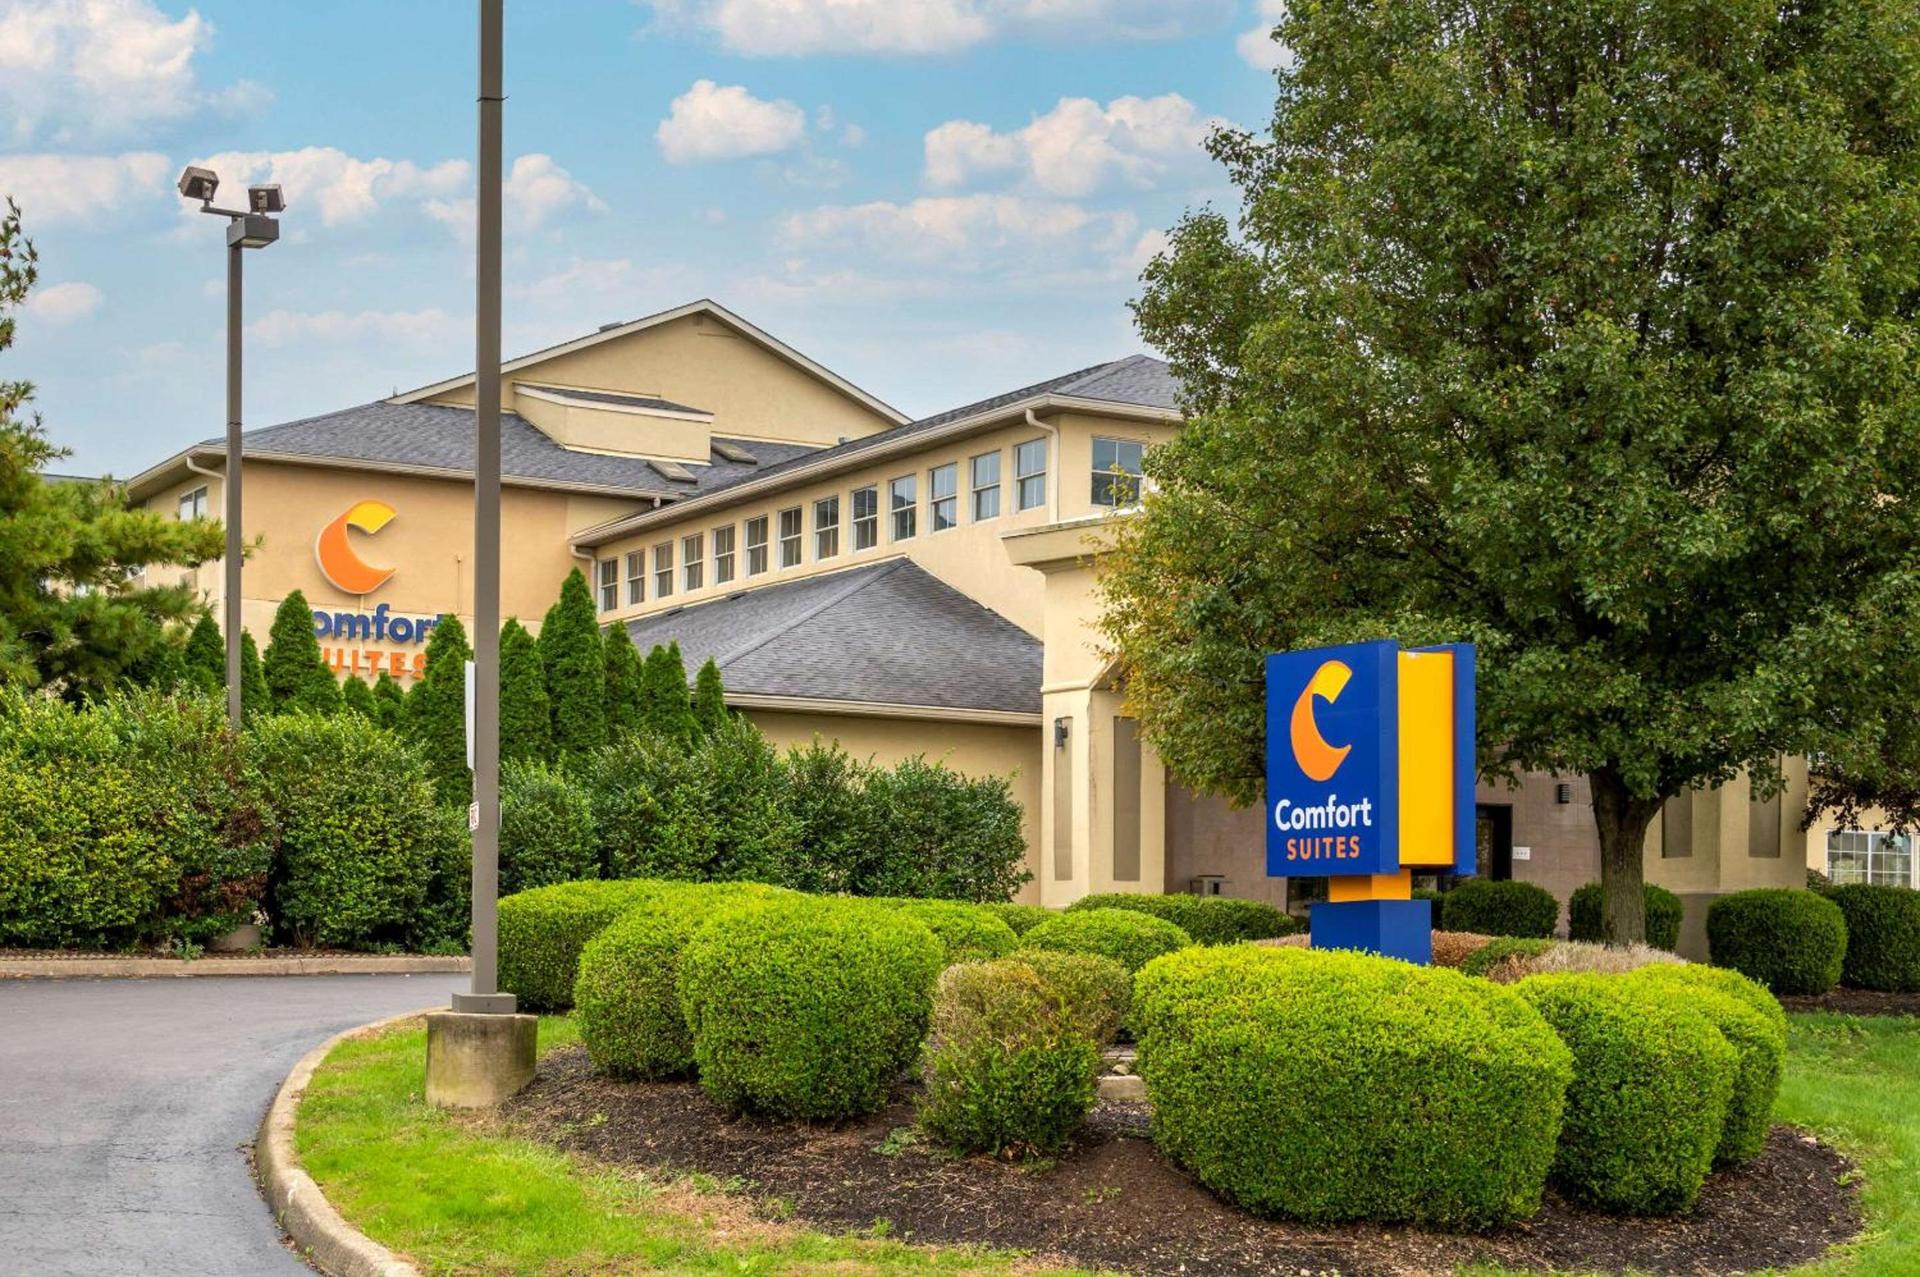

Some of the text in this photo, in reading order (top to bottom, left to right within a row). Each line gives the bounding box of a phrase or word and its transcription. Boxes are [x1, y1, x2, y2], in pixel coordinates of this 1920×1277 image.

[312, 603, 444, 644] omfor
[323, 647, 427, 680] UITES
[1275, 794, 1372, 831] Comfort
[1287, 835, 1360, 861] SUITES
